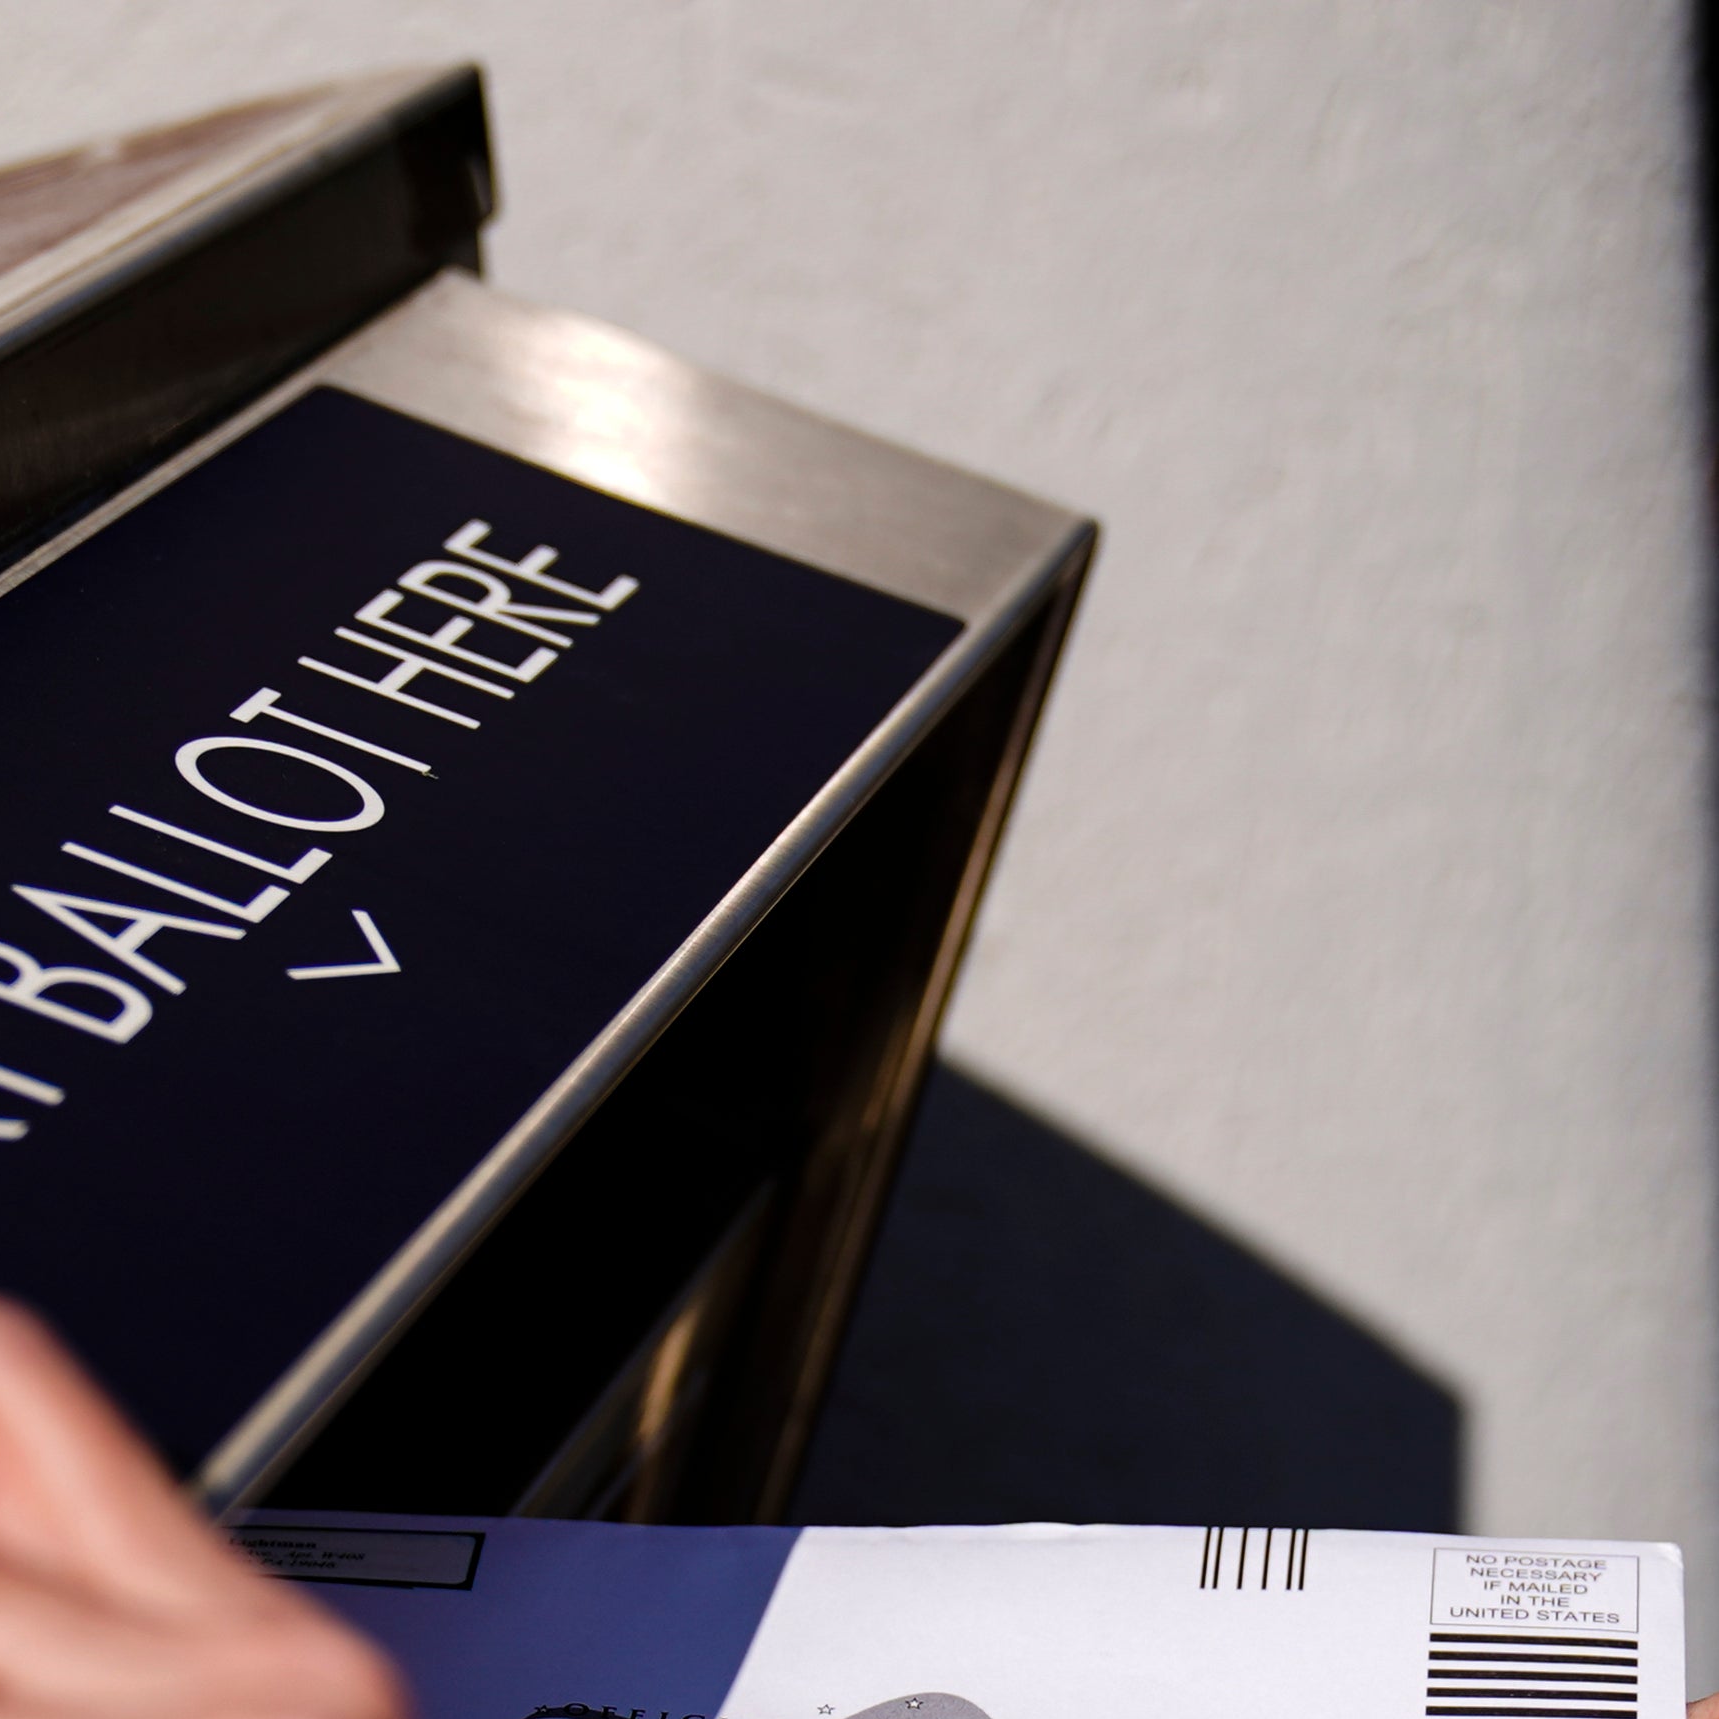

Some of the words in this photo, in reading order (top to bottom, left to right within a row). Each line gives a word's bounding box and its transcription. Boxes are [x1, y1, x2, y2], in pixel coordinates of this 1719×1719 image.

[297, 520, 640, 730] HERE
[1465, 1554, 1497, 1566] NO
[1504, 1556, 1607, 1570] POSTAGE
[1469, 1567, 1603, 1582] NECESSARY
[1483, 1581, 1501, 1591] IF
[1508, 1581, 1588, 1595] MAILED
[1500, 1595, 1521, 1606] IN
[1528, 1596, 1571, 1608] THE
[1449, 1607, 1530, 1620] UNITED
[1536, 1610, 1621, 1624] STATES
